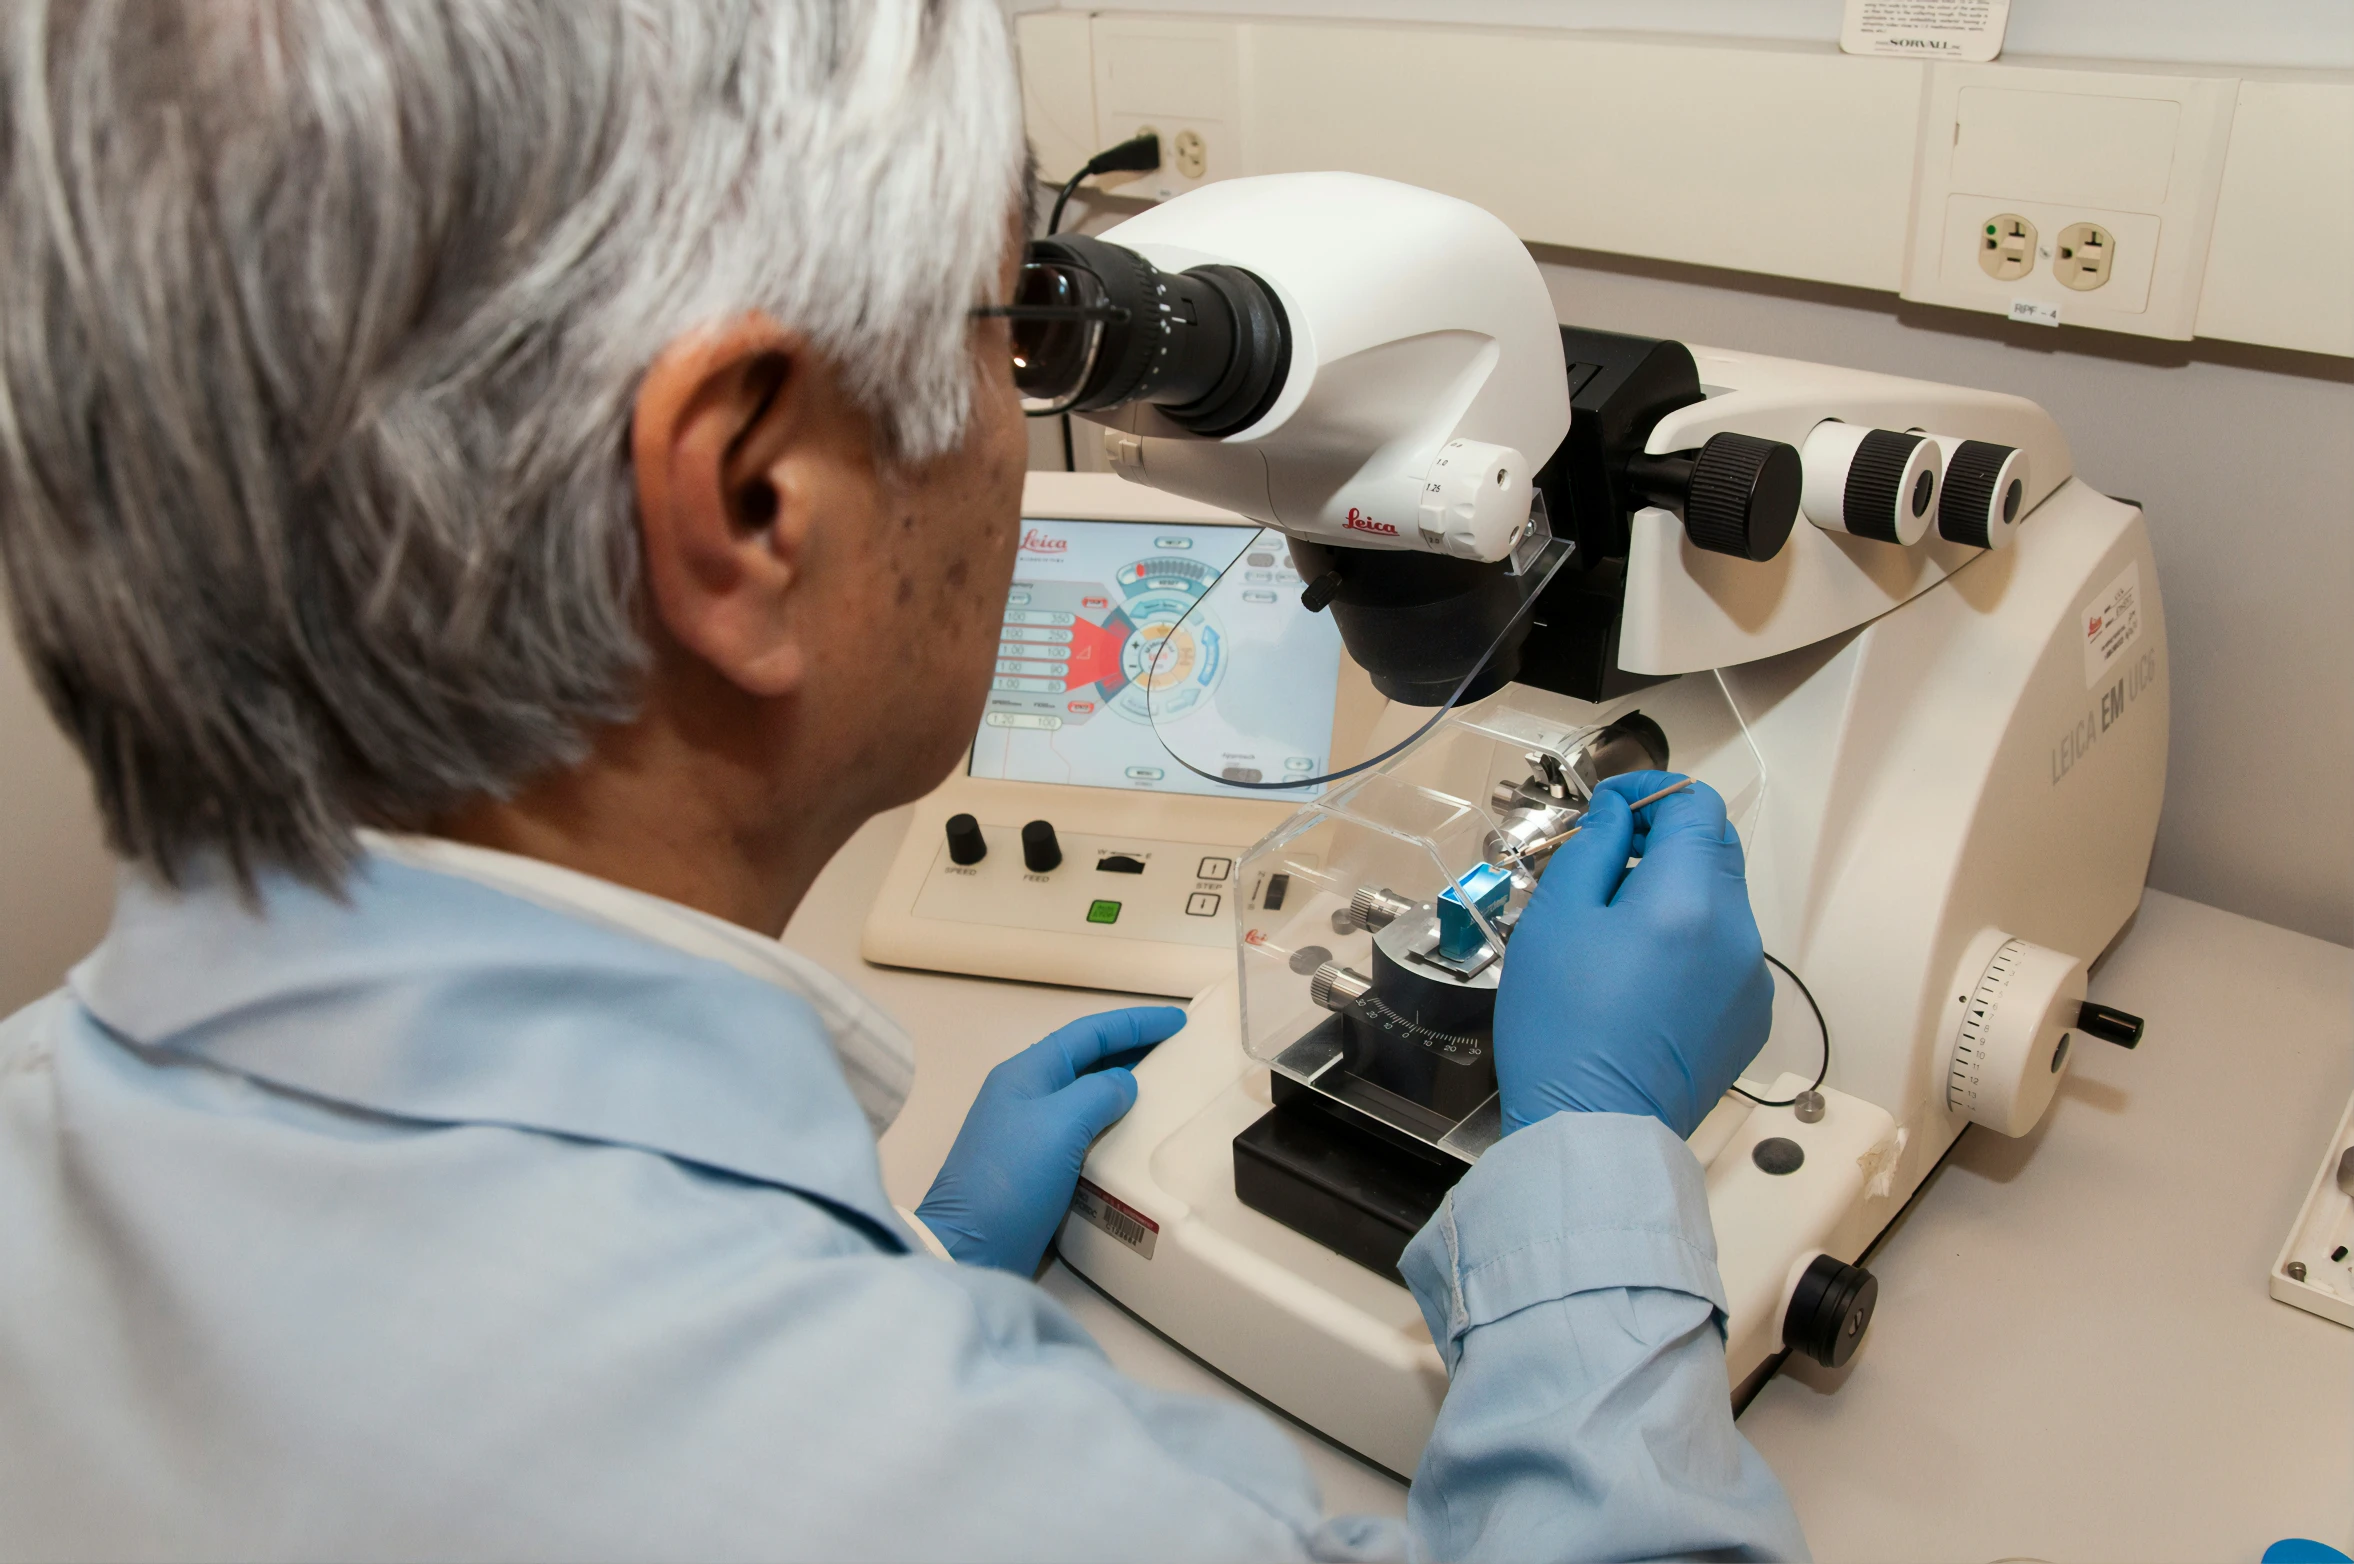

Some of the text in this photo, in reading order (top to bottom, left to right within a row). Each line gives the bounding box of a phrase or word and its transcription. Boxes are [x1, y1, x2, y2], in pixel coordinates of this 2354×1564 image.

[2050, 310, 2057, 319] 4
[1342, 507, 1400, 537] Leica
[1019, 528, 1068, 554] Leica
[2052, 709, 2097, 787] LEICA
[2101, 677, 2124, 734] EM
[2128, 647, 2155, 702] UC6
[944, 867, 977, 876] SPEED
[1023, 874, 1050, 883] FEED
[1196, 882, 1222, 890] STEP
[1992, 1002, 1998, 1011] 6
[1366, 1010, 1379, 1019] 20
[1383, 1022, 1393, 1030] 10
[1423, 1039, 1433, 1047] 10
[1444, 1045, 1457, 1053] 20
[1984, 1024, 1990, 1033] 8
[1980, 1037, 1986, 1046] 9
[1976, 1050, 1986, 1060] 10
[1973, 1063, 1980, 1071] 11
[1970, 1076, 1979, 1085] 12
[1968, 1090, 1977, 1099] 13
